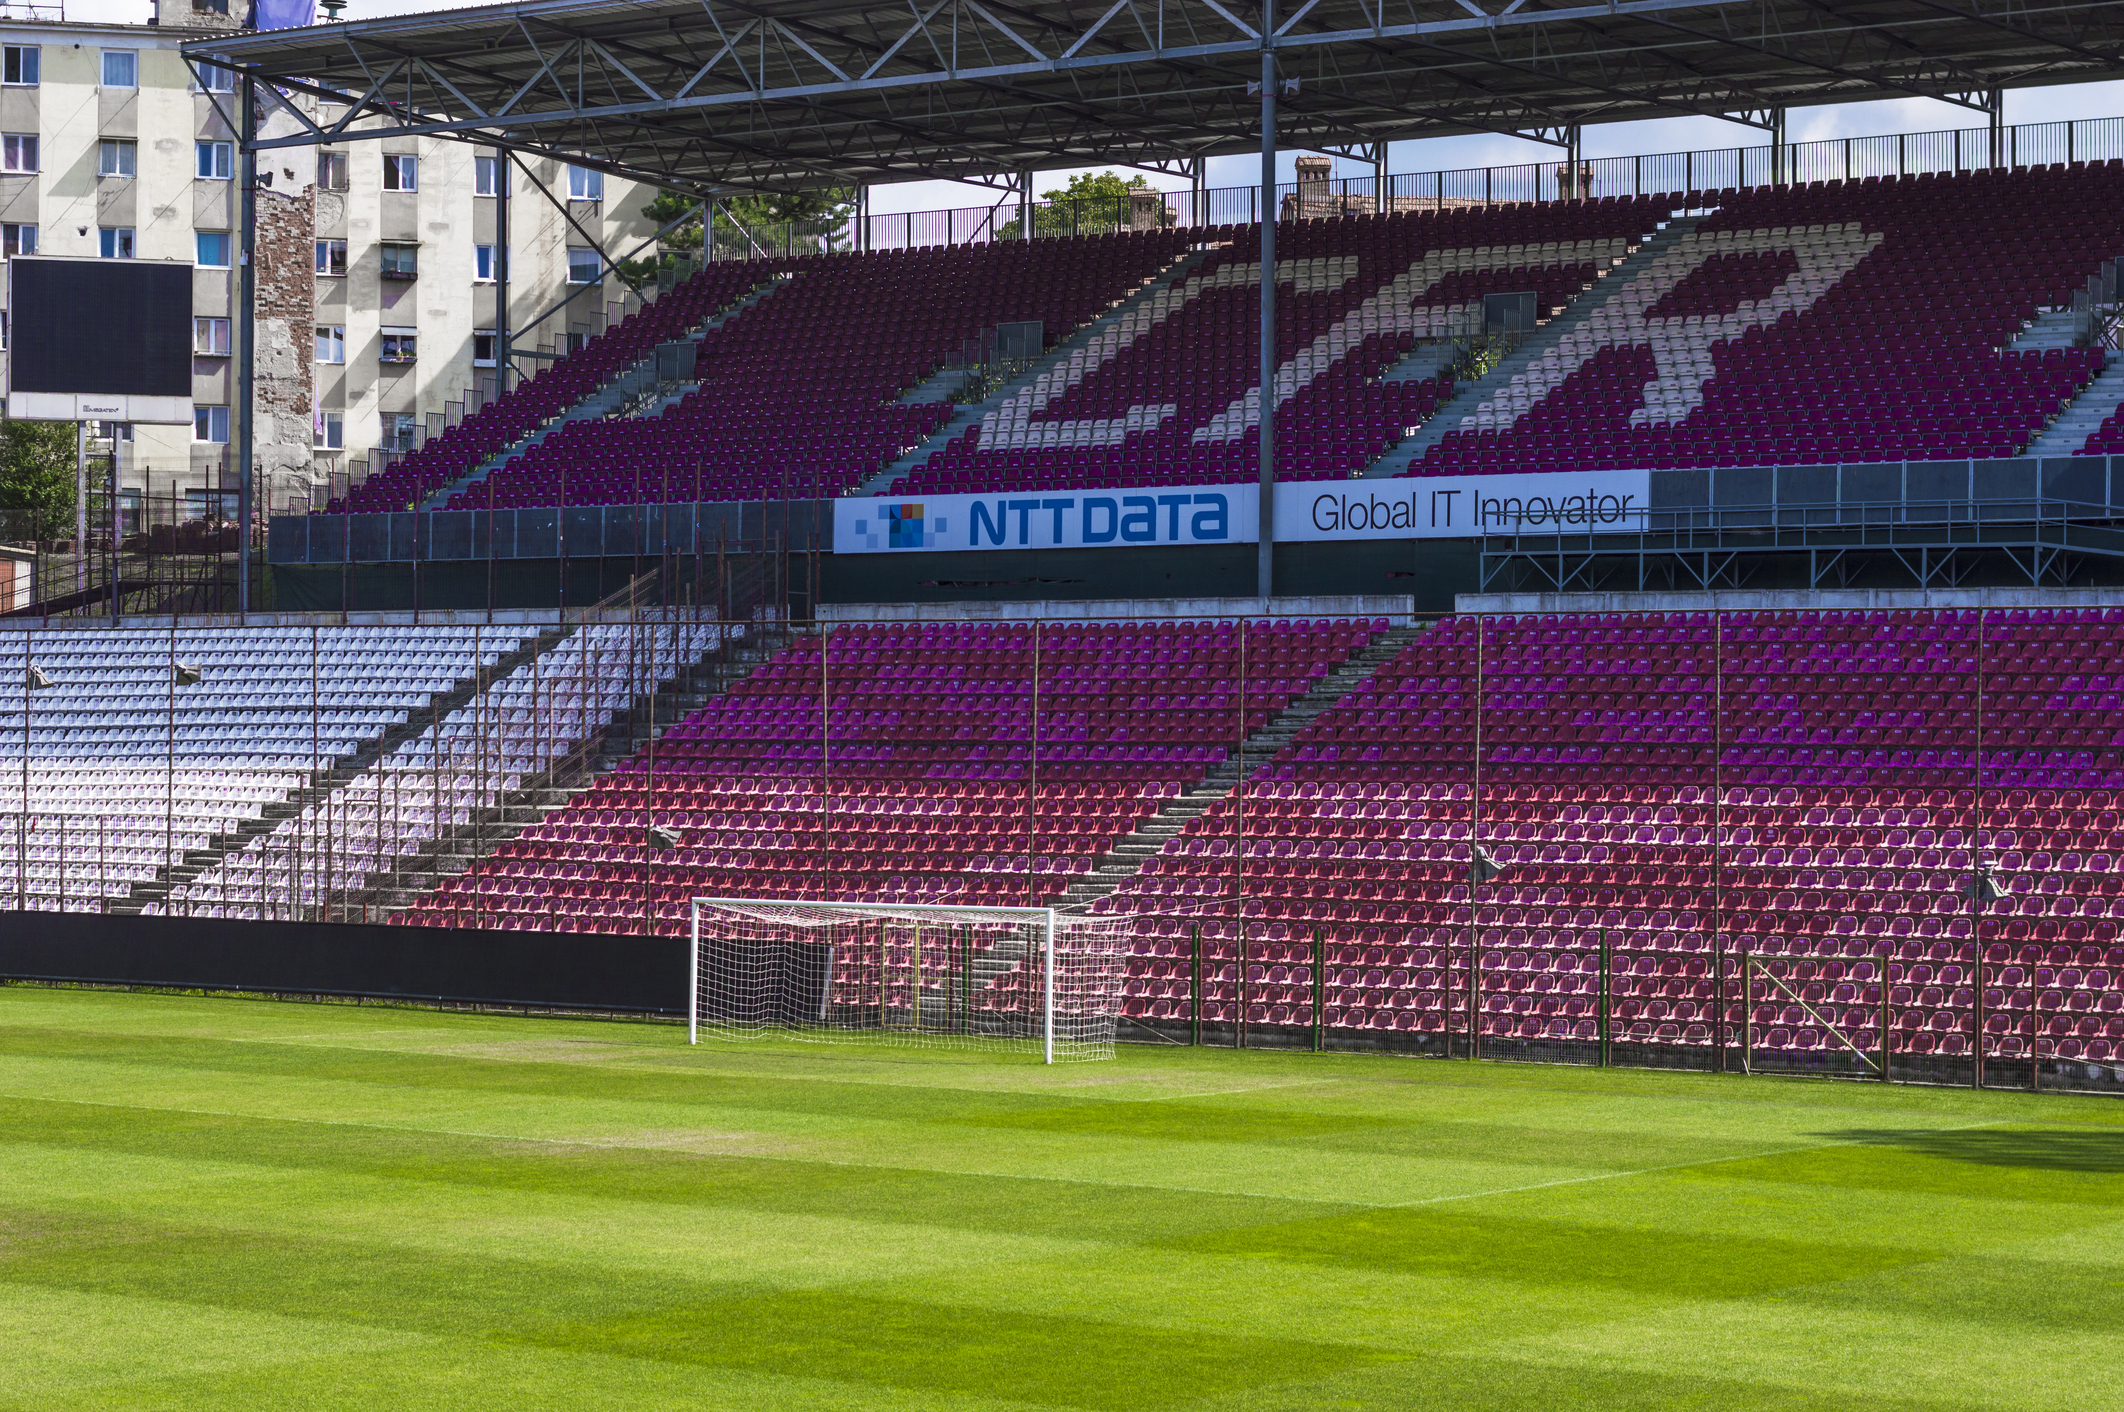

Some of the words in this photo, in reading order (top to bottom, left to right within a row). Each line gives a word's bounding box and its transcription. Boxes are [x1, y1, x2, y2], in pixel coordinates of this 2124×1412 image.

[969, 498, 1075, 546] NTT
[1312, 491, 1416, 531] Global
[1431, 490, 1462, 527] IT
[1474, 488, 1635, 527] Innovator
